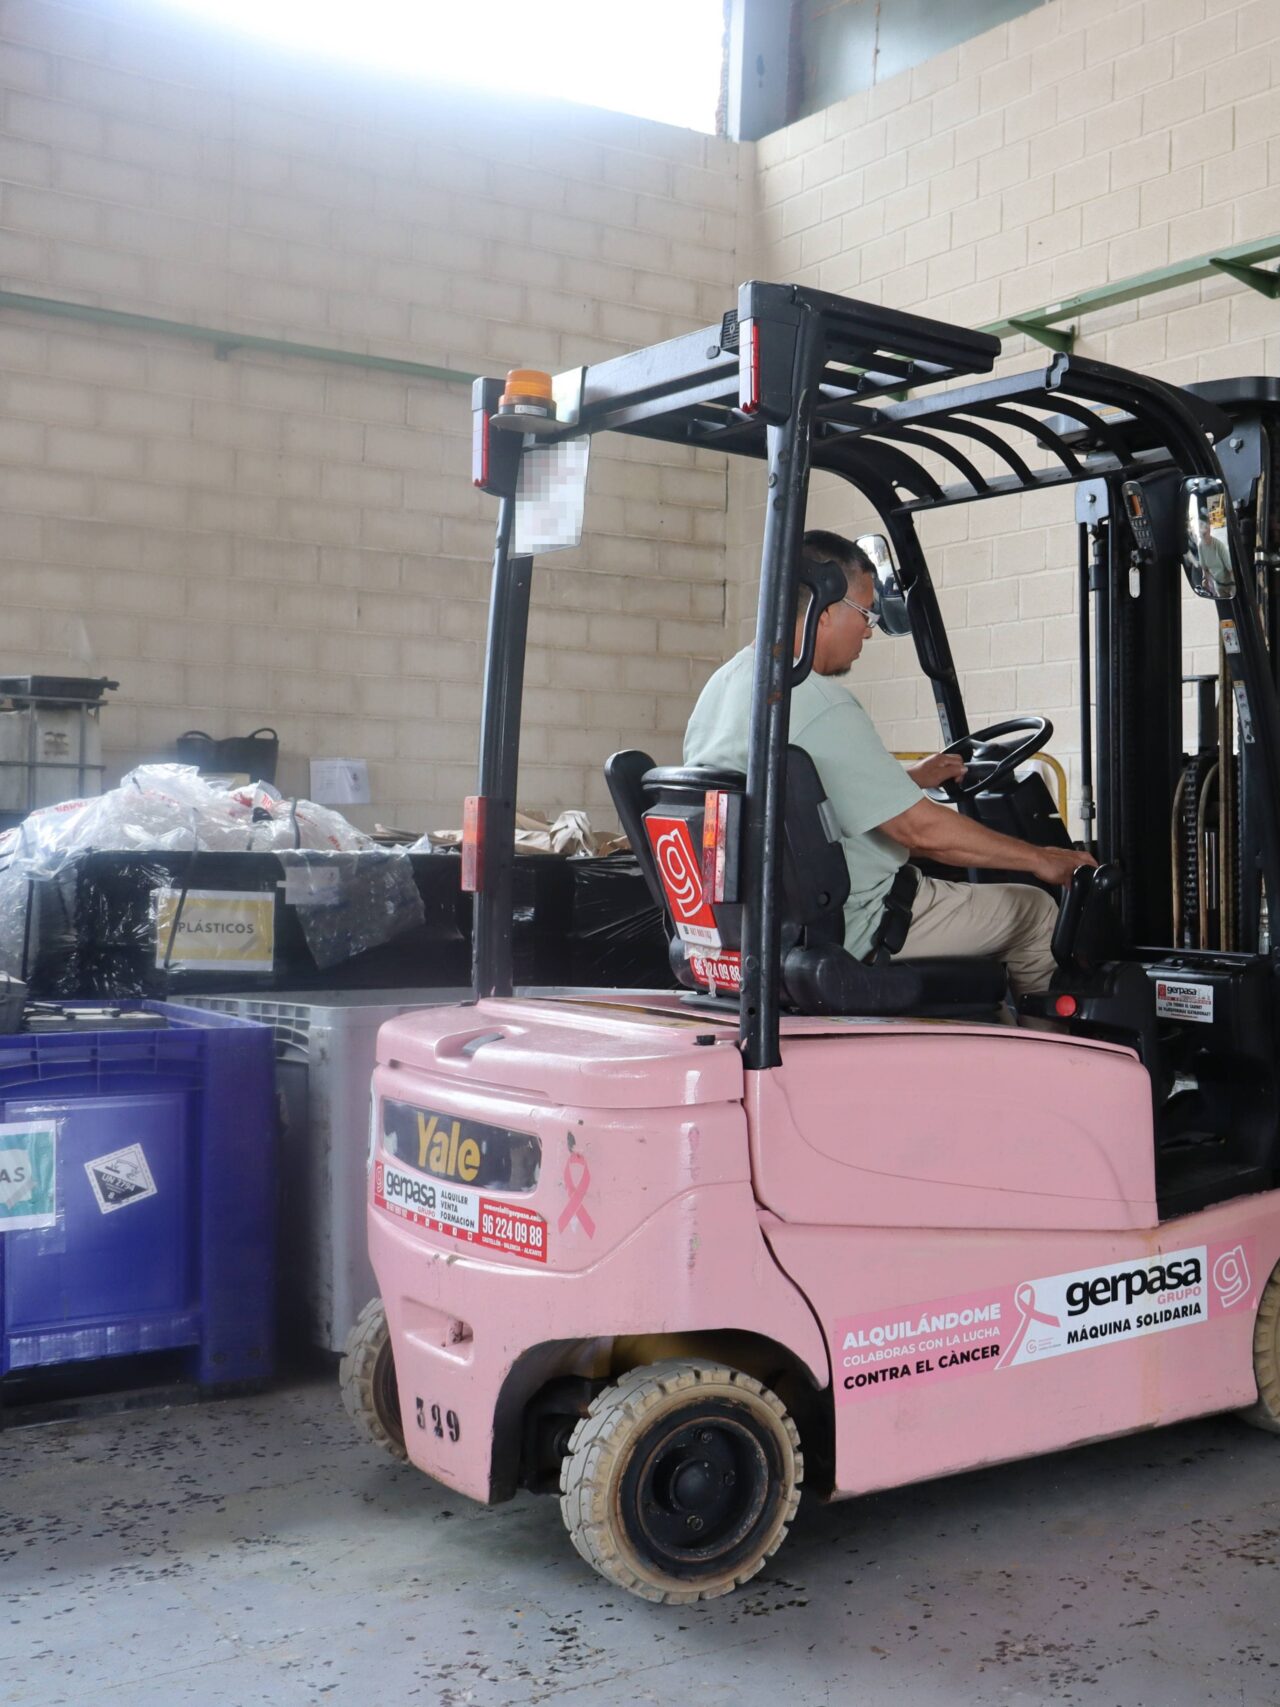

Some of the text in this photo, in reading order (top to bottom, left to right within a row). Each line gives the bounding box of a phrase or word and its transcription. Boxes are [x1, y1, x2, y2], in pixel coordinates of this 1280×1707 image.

[178, 919, 254, 934] PLÁSTICOS
[417, 1111, 480, 1182] Yale
[101, 1173, 116, 1184] UN
[115, 1180, 136, 1192] 2794
[386, 1170, 436, 1209] gerpasa
[441, 1190, 468, 1205] ALQUILER
[417, 1205, 436, 1218] GRUPO
[440, 1201, 458, 1213] VENTA
[482, 1214, 543, 1247] 96 224 09 88
[1065, 1258, 1202, 1317] gerpasa
[1157, 1286, 1202, 1306] GRUPO
[842, 1303, 1001, 1350] ALQUILÁNDOME
[1067, 1324, 1132, 1345] MÁQUINA
[1136, 1302, 1202, 1329] SOLIDARIA
[843, 1326, 1001, 1368] COLABORAS CON LA LUCHA
[844, 1364, 912, 1390] CONTRA
[916, 1360, 934, 1374] EL
